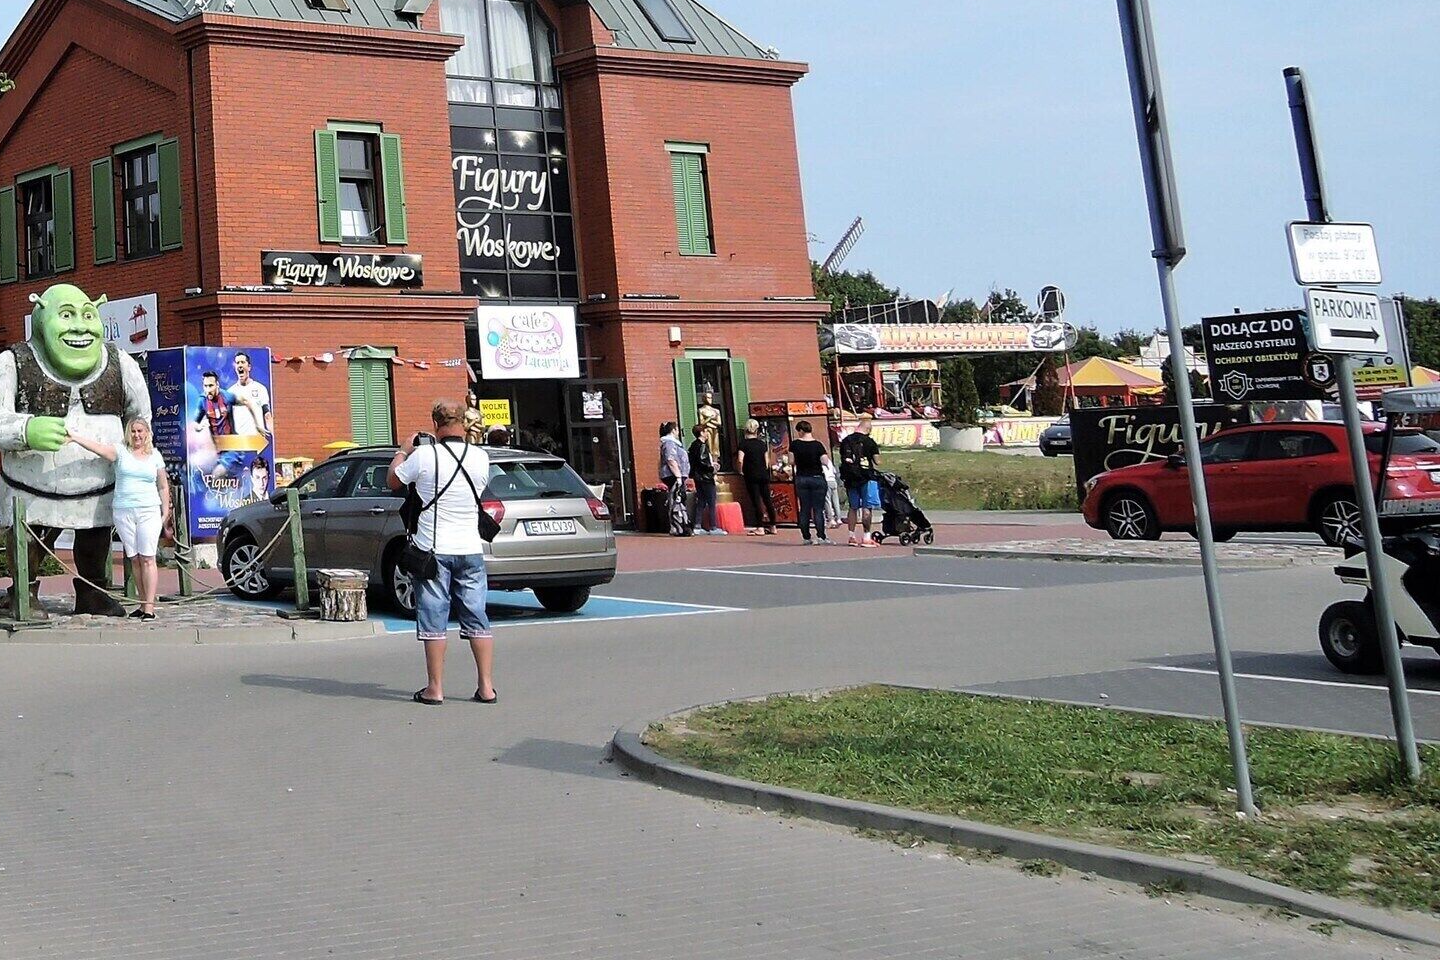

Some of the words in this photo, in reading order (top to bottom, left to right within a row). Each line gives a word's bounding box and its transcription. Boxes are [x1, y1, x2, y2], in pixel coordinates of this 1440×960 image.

[453, 155, 548, 227] Figury
[456, 223, 560, 268] Woskowe
[272, 257, 327, 285] Figury
[333, 255, 415, 286] Woskowe
[1313, 297, 1378, 321] PARKOMAT
[879, 324, 1031, 347] AUTOSCOOTER
[1210, 320, 1268, 338] DOŁĄCZ
[1270, 318, 1294, 332] DO
[1212, 340, 1253, 351] NASZEGO
[1254, 338, 1297, 349] SYSTEMU
[1215, 354, 1254, 365] OCHRONY
[1254, 351, 1298, 363] OBIEKTÓW
[482, 403, 507, 411] WOLNE
[205, 474, 240, 496] Figury
